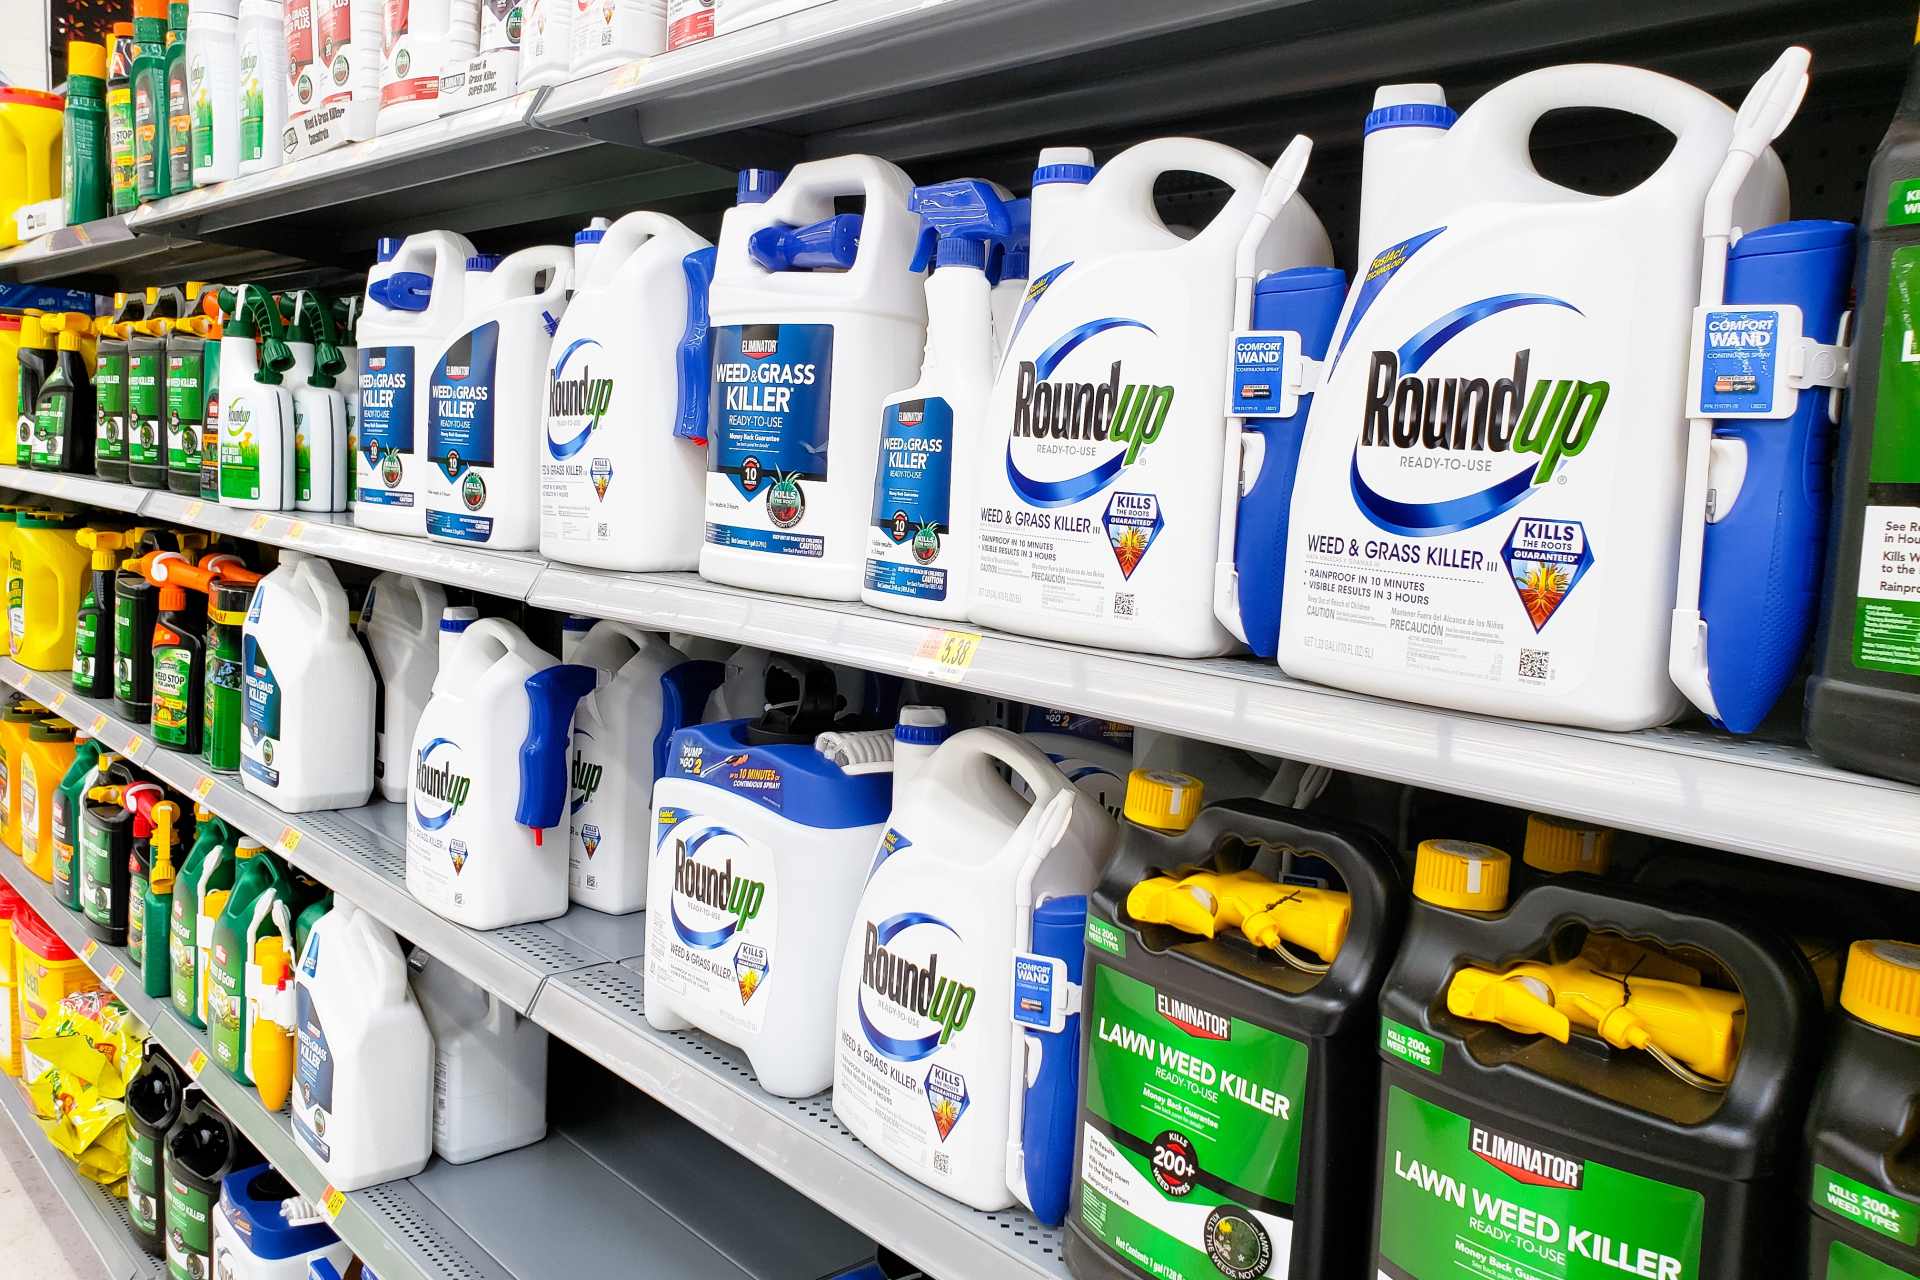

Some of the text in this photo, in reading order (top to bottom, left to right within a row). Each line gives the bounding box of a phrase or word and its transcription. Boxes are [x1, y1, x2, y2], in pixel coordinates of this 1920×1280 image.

[1708, 319, 1774, 331] COMFORT
[742, 339, 777, 353] ELIMINATOR
[1237, 343, 1282, 351] COMFORT
[1709, 331, 1771, 348] WAND
[1237, 351, 1280, 364] WAND
[549, 365, 614, 430] Roundup
[728, 415, 783, 428] READY-TO-USE
[1013, 359, 1175, 467] Roundup
[1361, 348, 1610, 485] Roundup
[1036, 443, 1097, 457] READY-TO-USE
[1400, 456, 1493, 472] READY-TO-USE
[744, 467, 757, 481] 10
[774, 490, 797, 500] KILLS
[1116, 495, 1151, 509] KILLS
[980, 506, 1091, 534] WEED & GRASS KILLER
[1116, 508, 1150, 518] THE ROOTS
[1523, 522, 1575, 542] KILLS
[1885, 521, 1906, 532] See
[1026, 540, 1054, 551] MINUTES
[1522, 539, 1573, 551] THE ROOTS
[1884, 533, 1894, 544] in
[1034, 551, 1057, 562] HOURS
[1307, 534, 1345, 555] WEED
[1348, 538, 1360, 557] &
[1364, 540, 1421, 564] GRASS
[1426, 547, 1483, 571] KILLER
[1882, 551, 1906, 562] Kills
[1881, 564, 1916, 575] to the
[1309, 568, 1425, 592] RAINPROOF IN 10 MINUTES
[1308, 580, 1430, 606] VISIBLE RESULTS IN 3 HOURS
[1306, 605, 1336, 620] CAUTION
[1390, 618, 1444, 637] PRECAUCIÓN
[416, 749, 471, 816] Roundup
[747, 769, 776, 781] MINUTES
[675, 838, 765, 931] Roundup
[1101, 928, 1118, 943] 200+
[742, 945, 764, 959] KILLS
[711, 961, 732, 980] KILLER
[1016, 962, 1051, 974] COMFORT
[1017, 969, 1049, 984] WAND
[862, 920, 976, 1045] Roundup
[1157, 993, 1228, 1039] ELIMINATOR
[1387, 1028, 1432, 1055] KILLS 200+
[1386, 1039, 1431, 1067] WEED TYPES
[863, 1050, 888, 1076] GRASS
[890, 1066, 917, 1094] KILLER
[935, 1068, 960, 1087] KILLS
[1099, 1017, 1155, 1061] LAWN
[1159, 1042, 1217, 1085] WEED
[1219, 1070, 1291, 1121] KILLER
[1155, 1066, 1219, 1104] READY-TO-USE
[1142, 1087, 1166, 1105] Money
[1167, 1098, 1183, 1112] Back
[1183, 1107, 1219, 1129] Guarantee
[1168, 1131, 1189, 1148] KILLS
[1153, 1144, 1196, 1178] 200+
[1472, 1127, 1579, 1187] ELIMINATOR
[1153, 1167, 1191, 1195] WEED TYPES
[1828, 1182, 1900, 1220] KILLS 200+
[1394, 1151, 1682, 1280] LAWN WEED KILLER
[1826, 1192, 1900, 1233] WEED TYPES
[1115, 1235, 1149, 1266] Net Contents
[1206, 1234, 1215, 1253] THE
[1257, 1232, 1270, 1258] LAWN
[1469, 1217, 1567, 1266] READY-TO-USE
[1256, 1257, 1268, 1273] THE
[1454, 1239, 1513, 1273] Money Back
[1238, 1269, 1256, 1280] NOT
